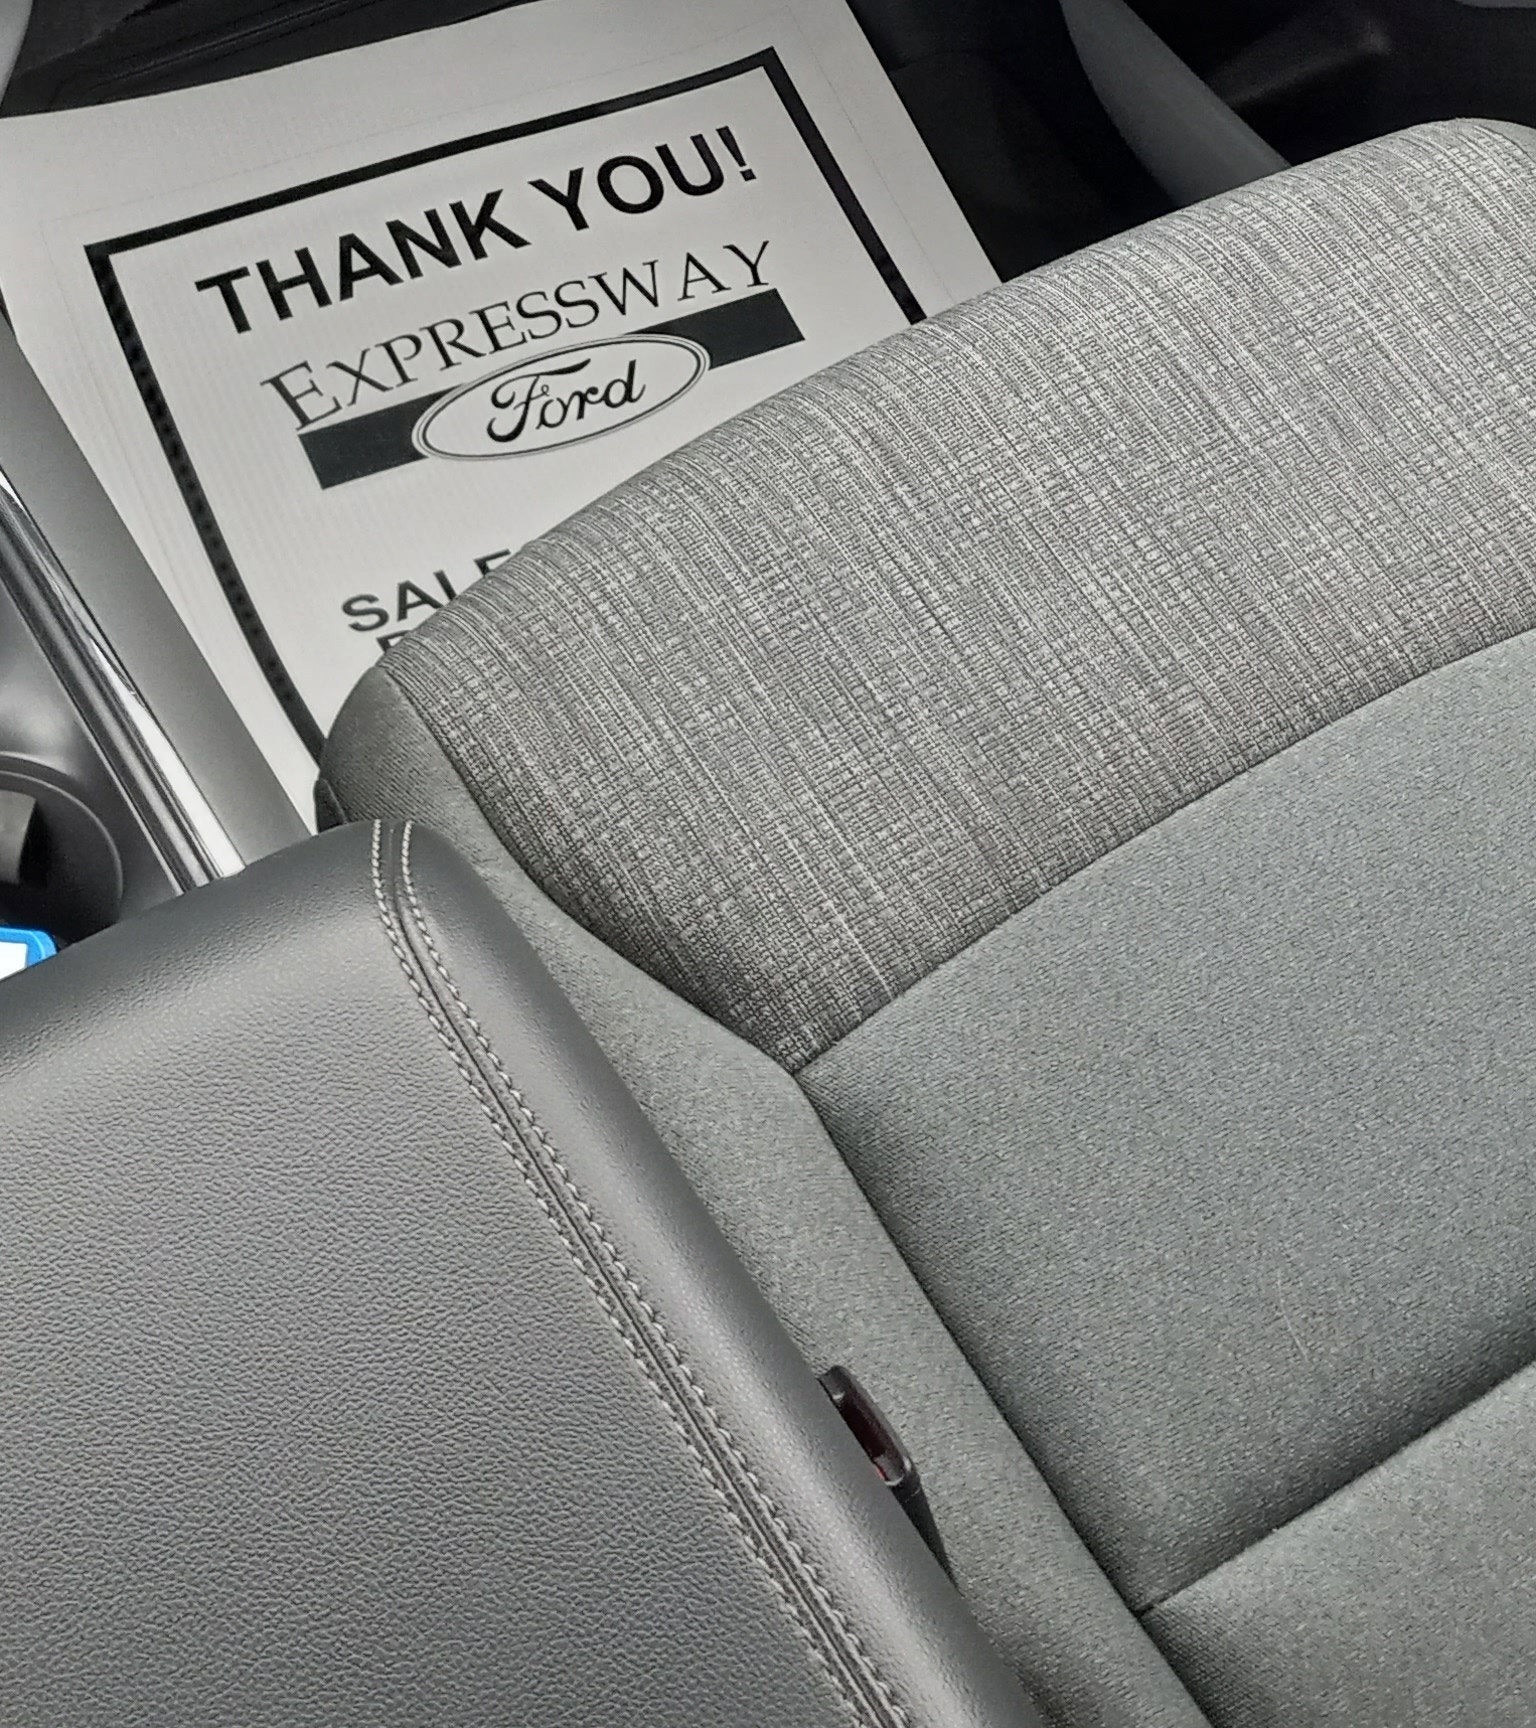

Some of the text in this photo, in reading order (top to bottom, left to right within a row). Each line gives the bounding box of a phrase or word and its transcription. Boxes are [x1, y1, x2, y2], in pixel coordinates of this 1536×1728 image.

[195, 123, 759, 336] THANK YOU!
[261, 239, 775, 433] EXPRESSWAY
[484, 358, 648, 445] Ford
